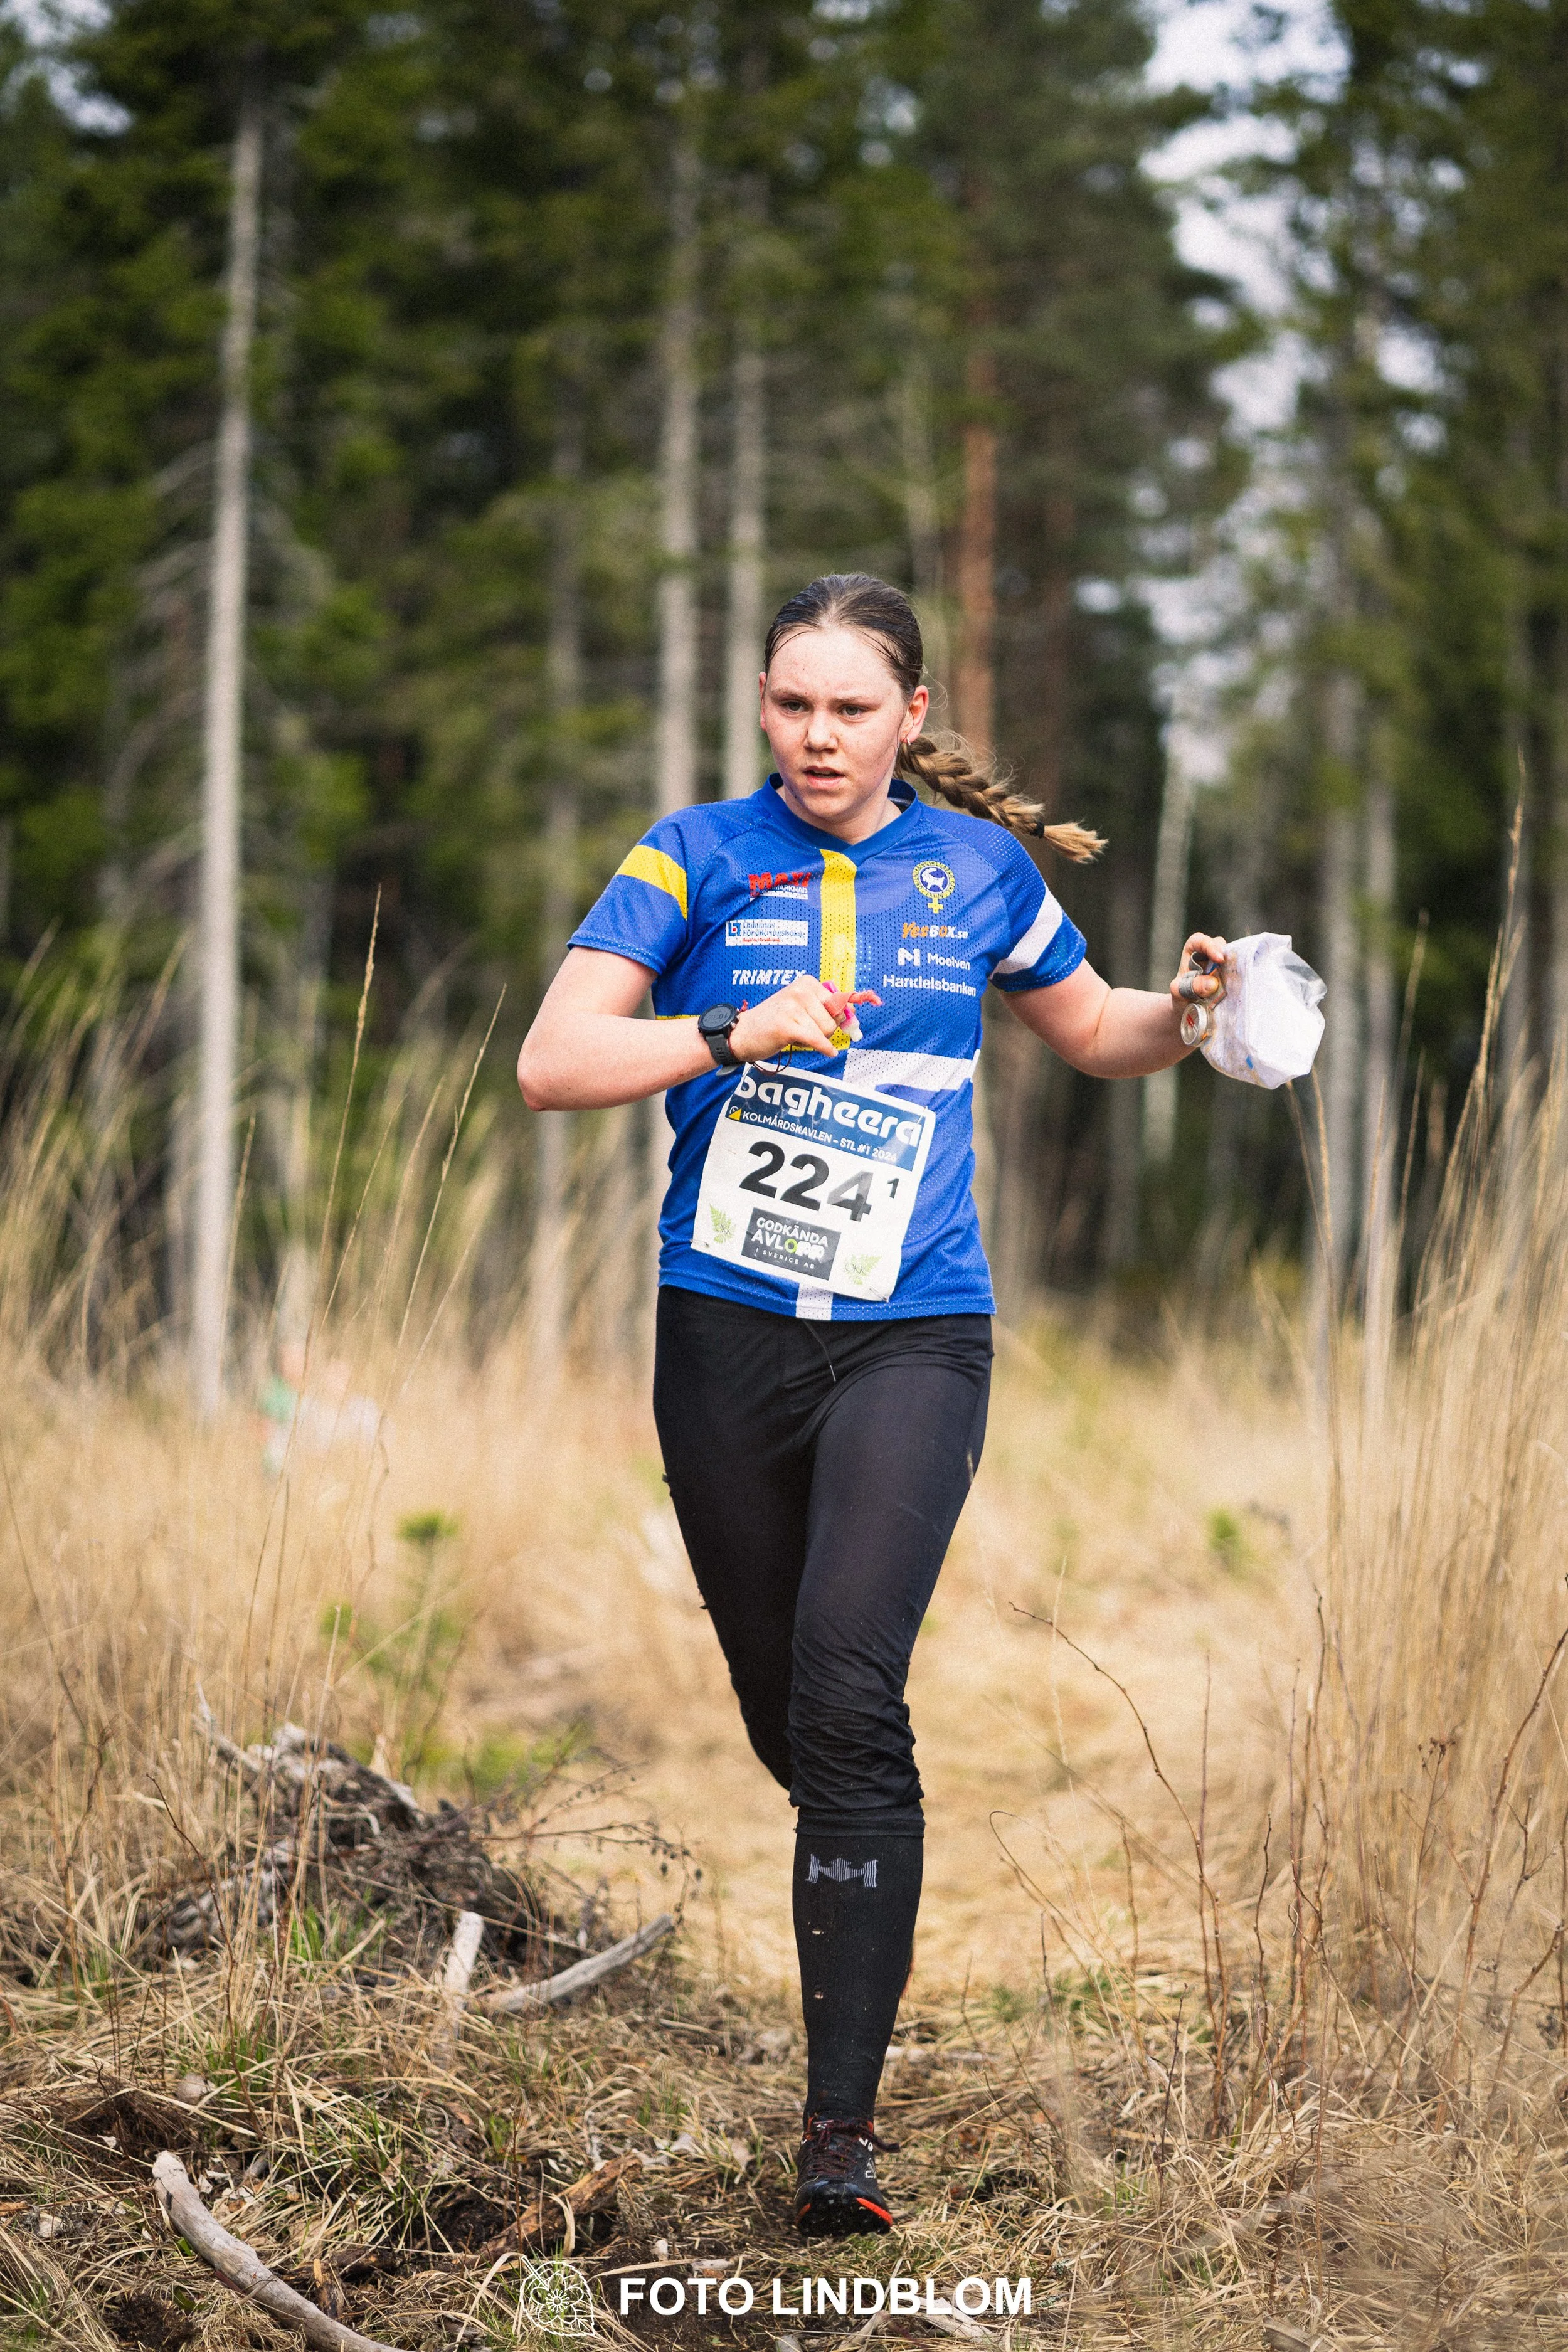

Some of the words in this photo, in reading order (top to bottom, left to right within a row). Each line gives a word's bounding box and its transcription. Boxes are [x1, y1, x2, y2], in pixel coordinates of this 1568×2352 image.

[748, 871, 812, 890] MAXI
[902, 921, 968, 938] YesBOX.se
[927, 952, 970, 970] Moelven
[883, 974, 977, 997] Handelsbanken
[734, 1075, 922, 1147] bagheera
[743, 1111, 833, 1143] KOLMÅRDSKAVLEN
[840, 1138, 856, 1152] STL
[857, 1143, 871, 1155] #1
[739, 1141, 874, 1222] 224
[887, 1177, 899, 1199] 1
[756, 1217, 829, 1247] GODKÄNDA
[763, 1249, 799, 1264] SVERIGE
